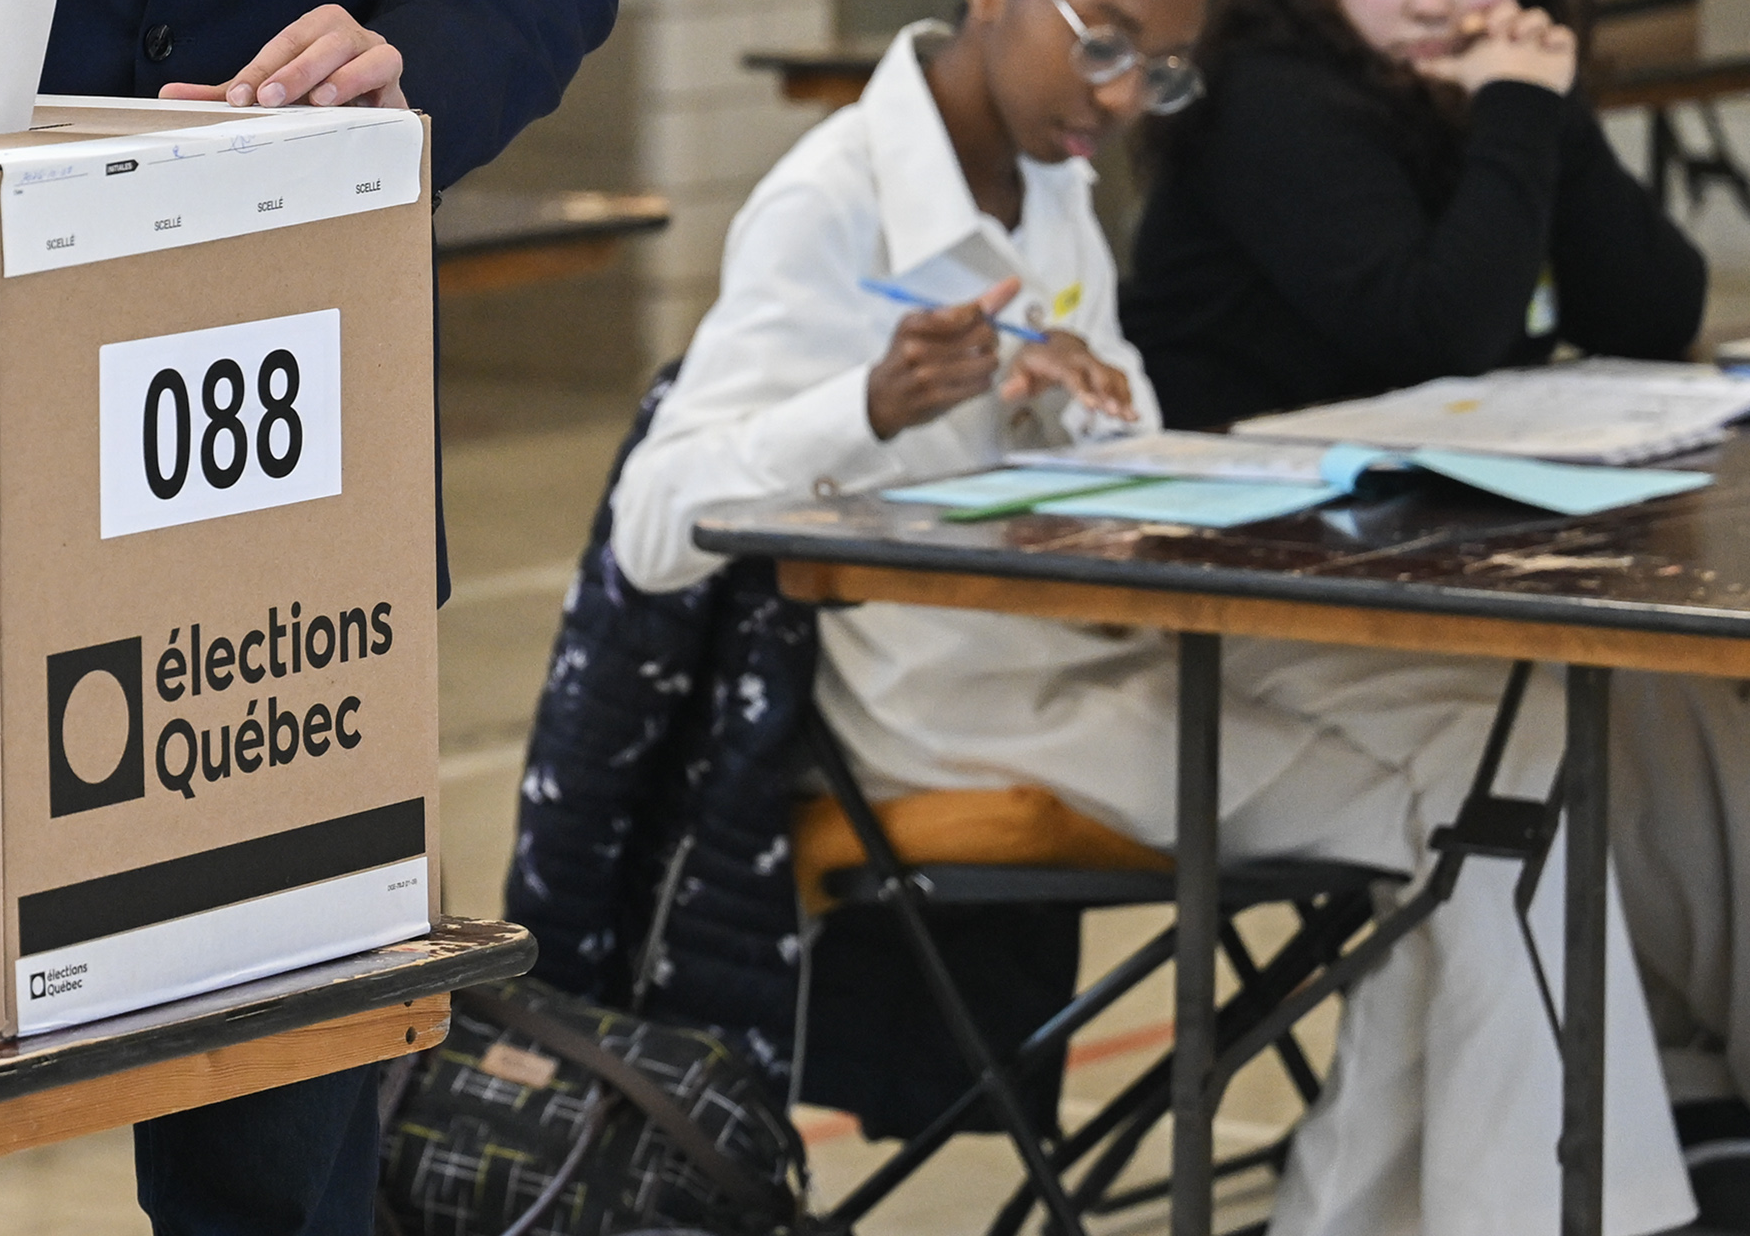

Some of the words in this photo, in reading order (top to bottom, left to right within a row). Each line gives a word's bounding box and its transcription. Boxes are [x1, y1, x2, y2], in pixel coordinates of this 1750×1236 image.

[355, 178, 381, 194] SCELLÉ
[257, 196, 284, 212] SCELLÉ
[154, 215, 182, 231] SCELLÉ
[46, 234, 75, 250] SCELLÉ
[142, 348, 303, 501] 088
[155, 600, 394, 703] élections
[155, 695, 363, 800] Québec
[47, 963, 88, 982] élections
[47, 979, 83, 997] Québec
